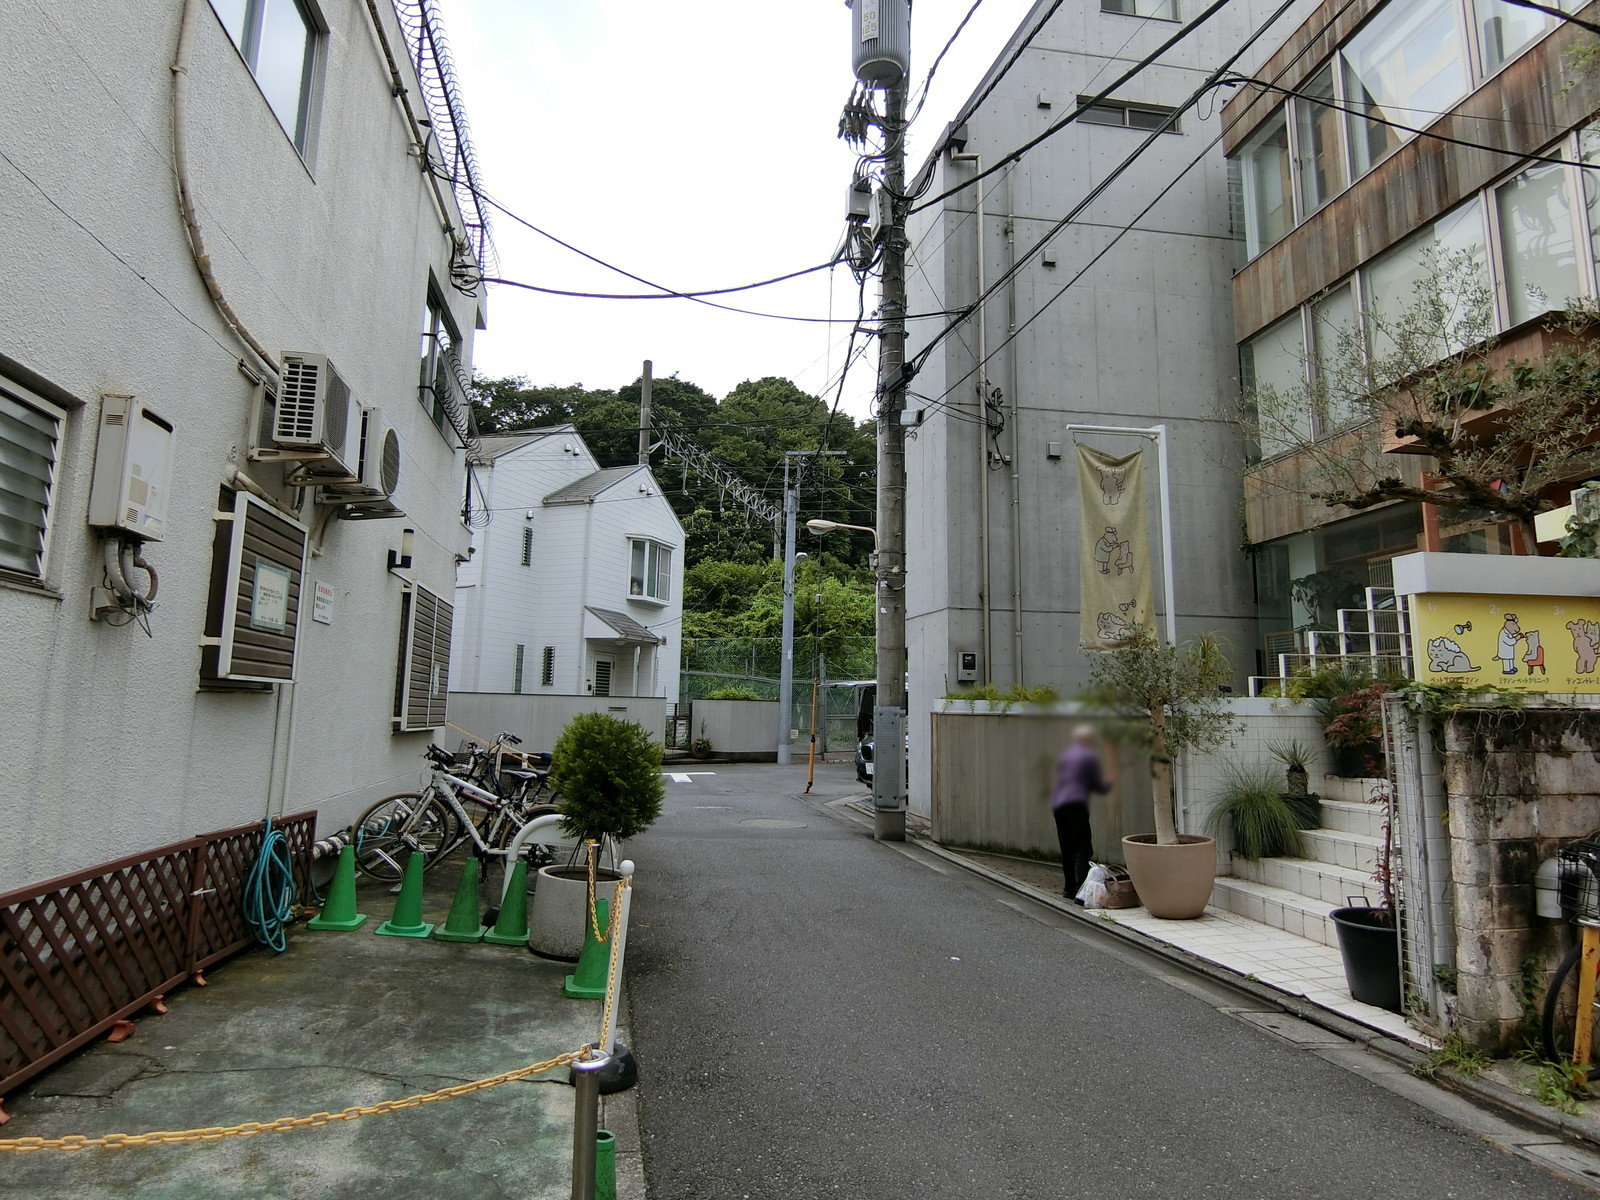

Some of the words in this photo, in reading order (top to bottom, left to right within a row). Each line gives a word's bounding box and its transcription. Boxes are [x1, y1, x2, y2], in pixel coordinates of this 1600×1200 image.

[863, 11, 876, 22] 50
[862, 23, 877, 35] 125
[1489, 604, 1502, 615] 2F
